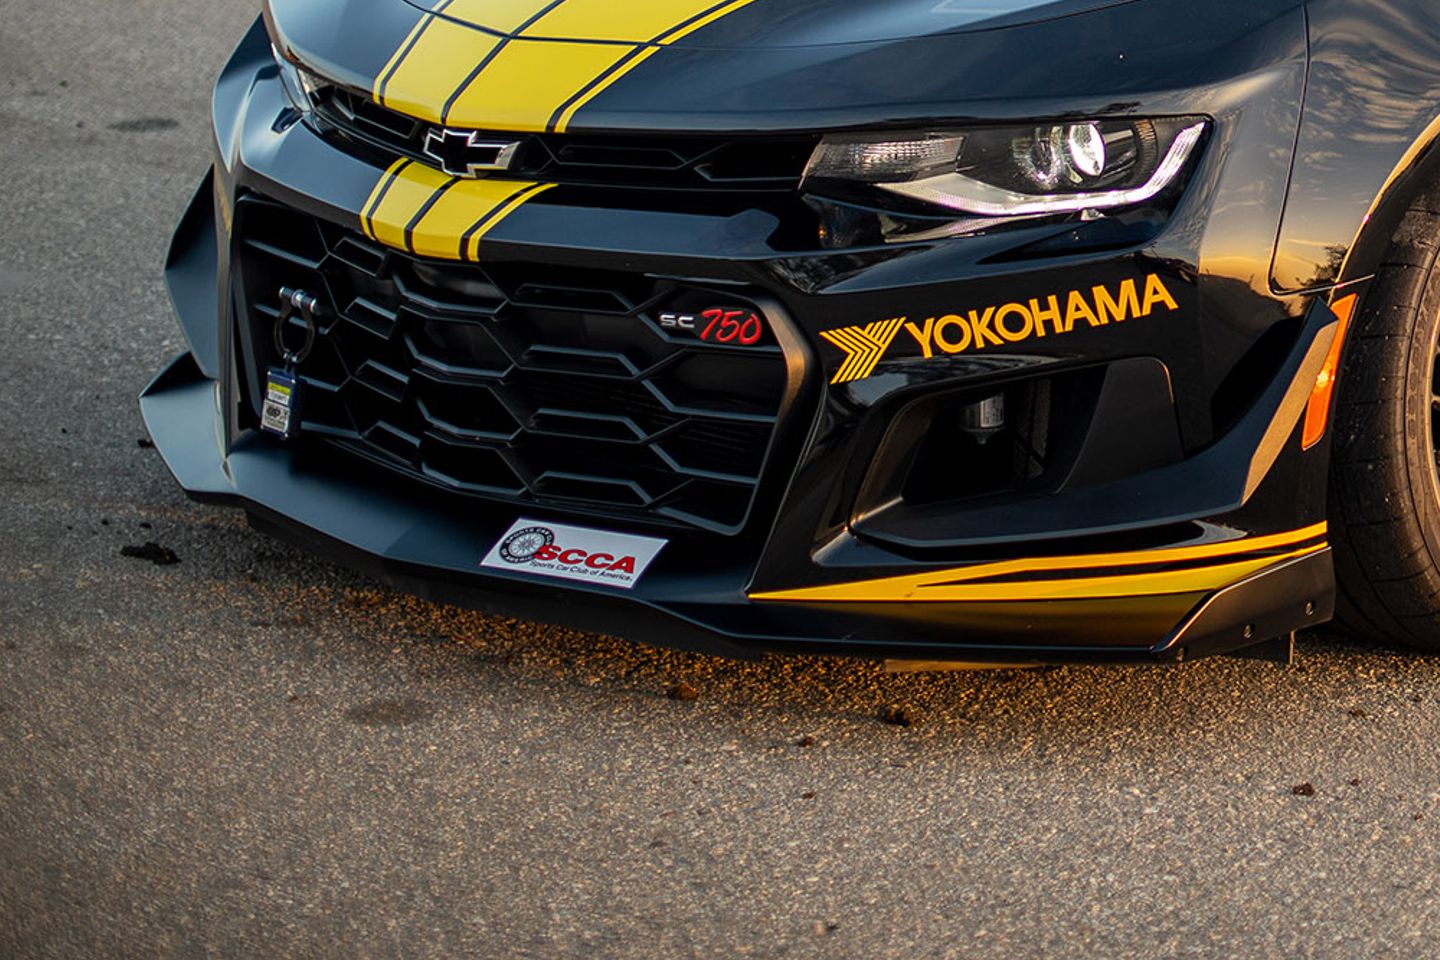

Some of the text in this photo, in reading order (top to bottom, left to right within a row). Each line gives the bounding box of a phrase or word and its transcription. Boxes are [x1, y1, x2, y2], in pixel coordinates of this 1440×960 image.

[660, 308, 762, 345] SC 750
[904, 273, 1179, 359] YOKOHAMA
[529, 559, 555, 569] Sports
[556, 563, 569, 571] Car
[569, 565, 589, 574] Club
[532, 544, 637, 574] SCCA
